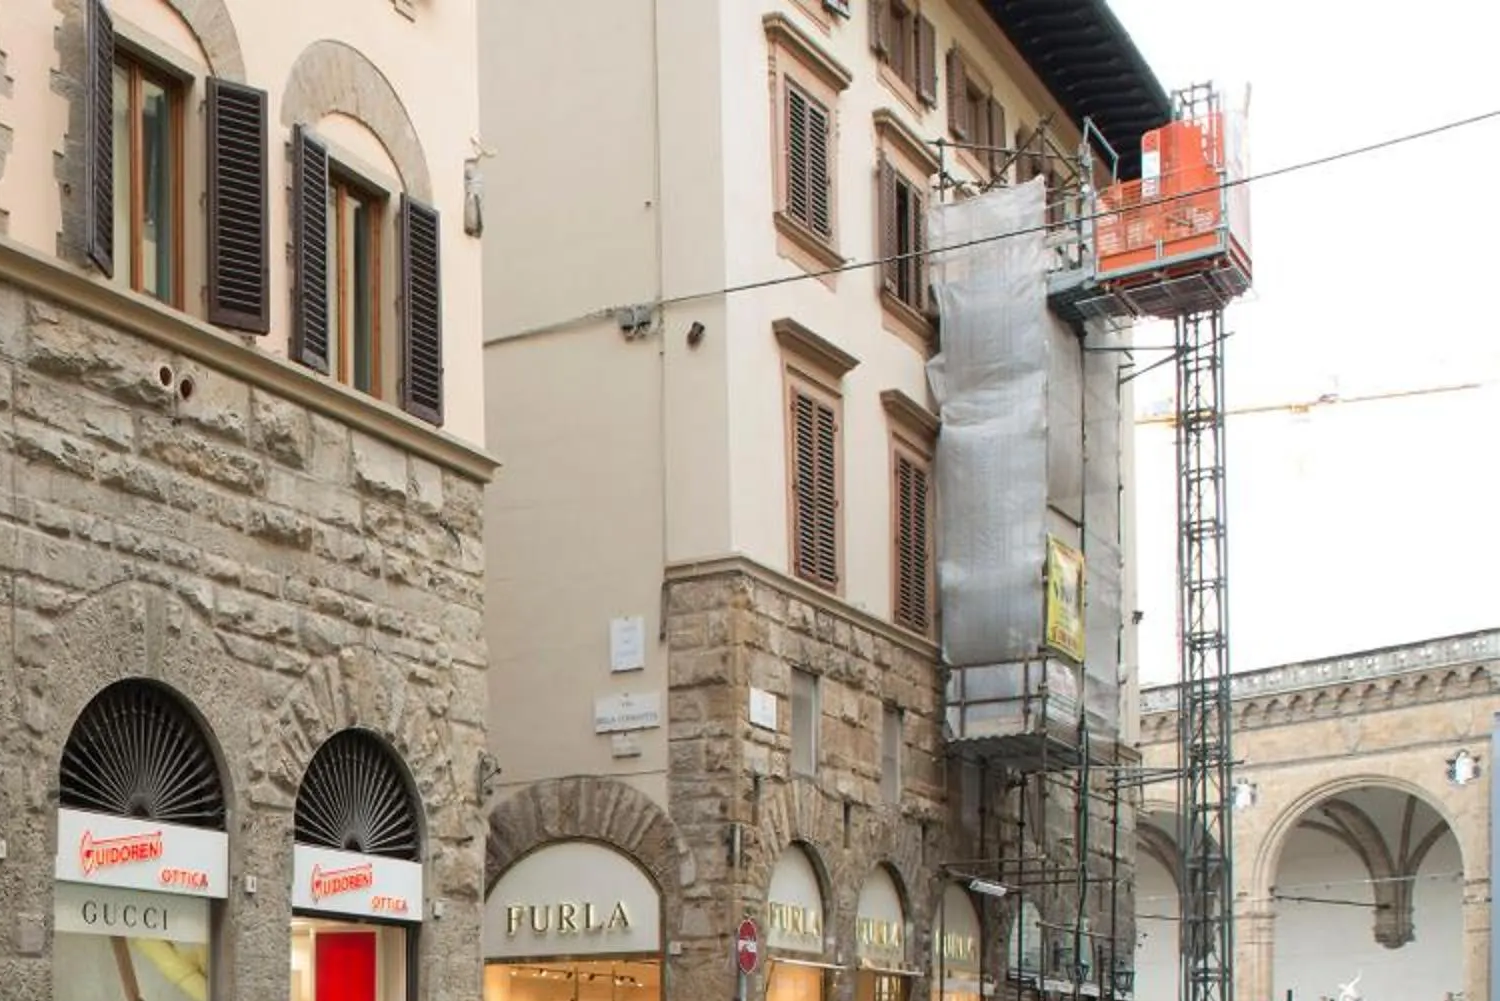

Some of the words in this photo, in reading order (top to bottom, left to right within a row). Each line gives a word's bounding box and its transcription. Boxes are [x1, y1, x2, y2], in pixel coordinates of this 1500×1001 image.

[160, 868, 209, 888] OTTICA
[81, 900, 169, 931] GUCCI
[504, 900, 630, 935] FURLA
[768, 901, 821, 937] FURLA
